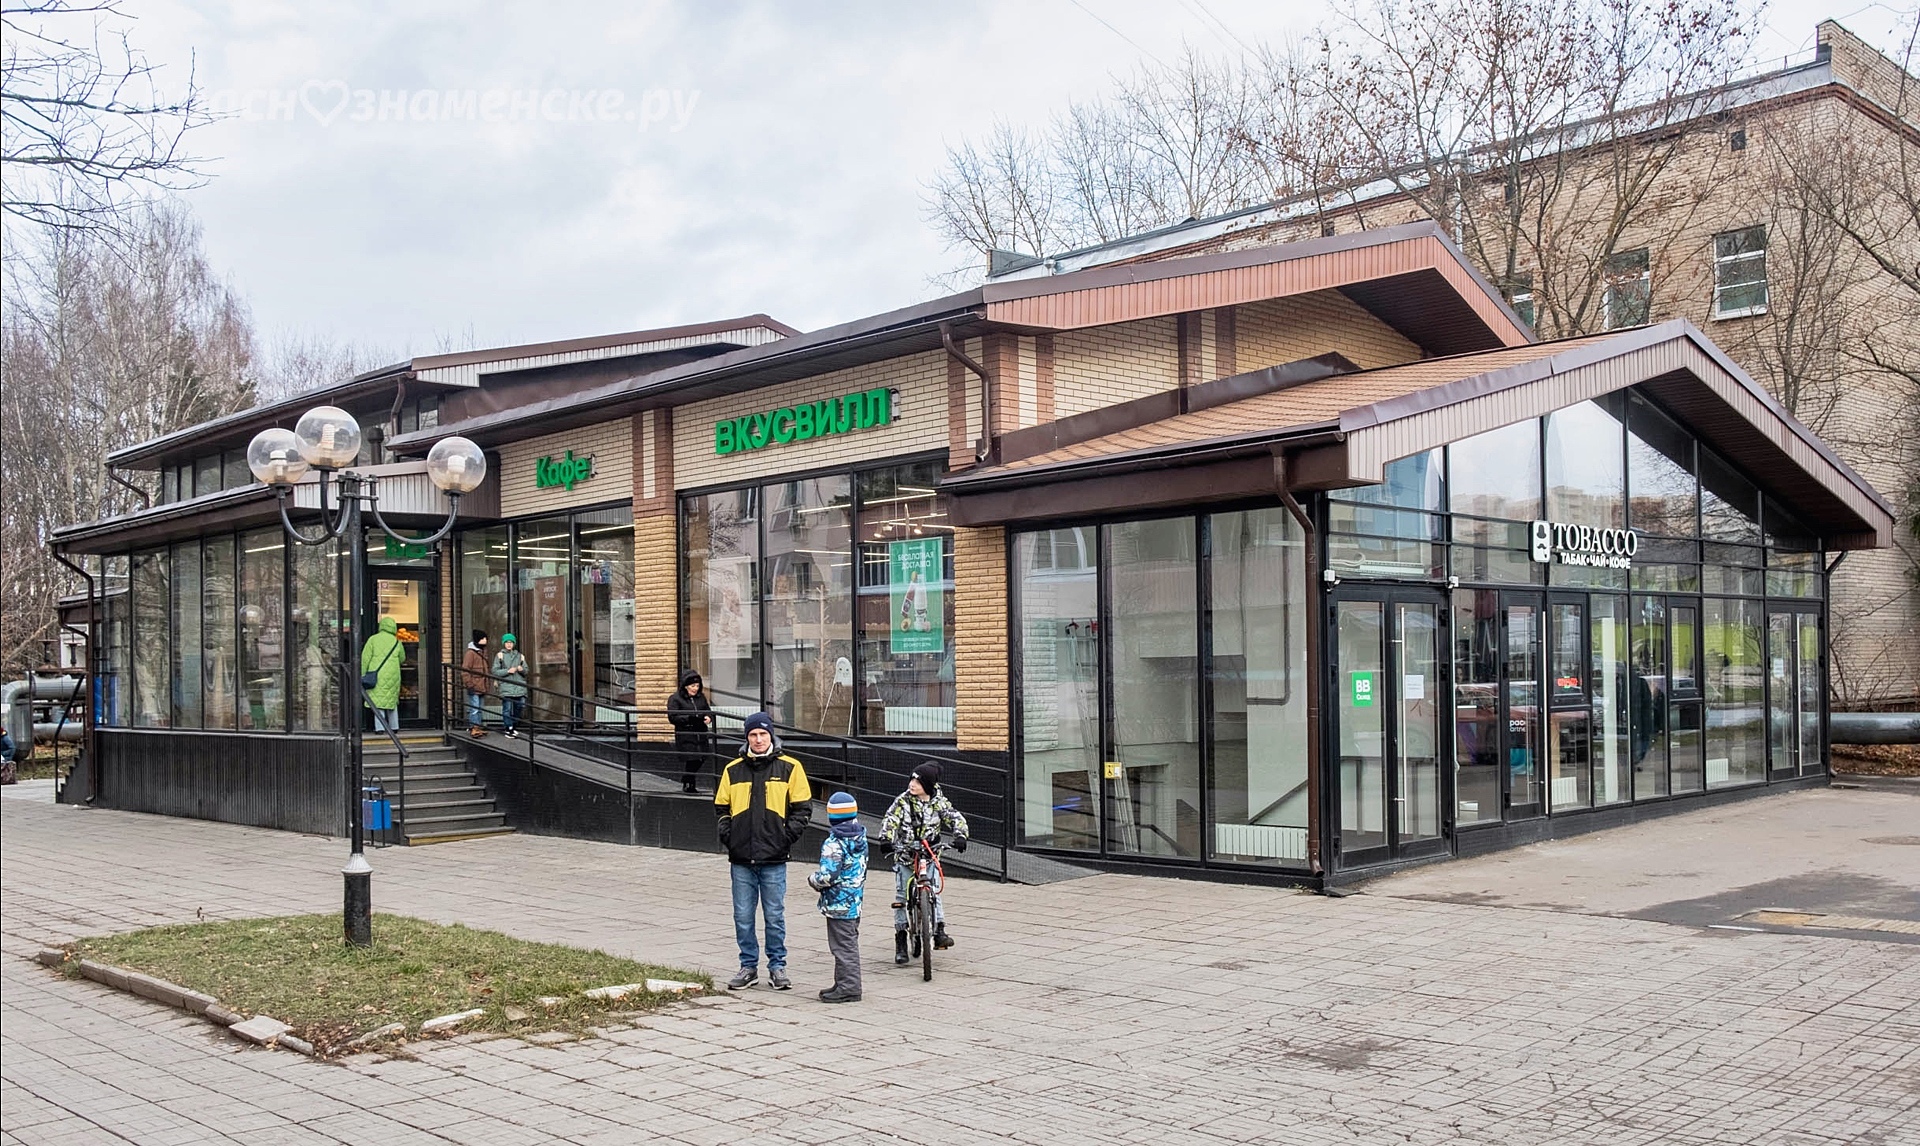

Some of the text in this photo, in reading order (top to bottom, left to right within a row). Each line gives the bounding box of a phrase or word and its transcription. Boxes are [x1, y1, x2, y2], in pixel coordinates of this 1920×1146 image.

[716, 387, 890, 455] ВКУСВИЛЛ
[536, 450, 589, 491] Кафе
[1553, 522, 1637, 555] TOBACCO
